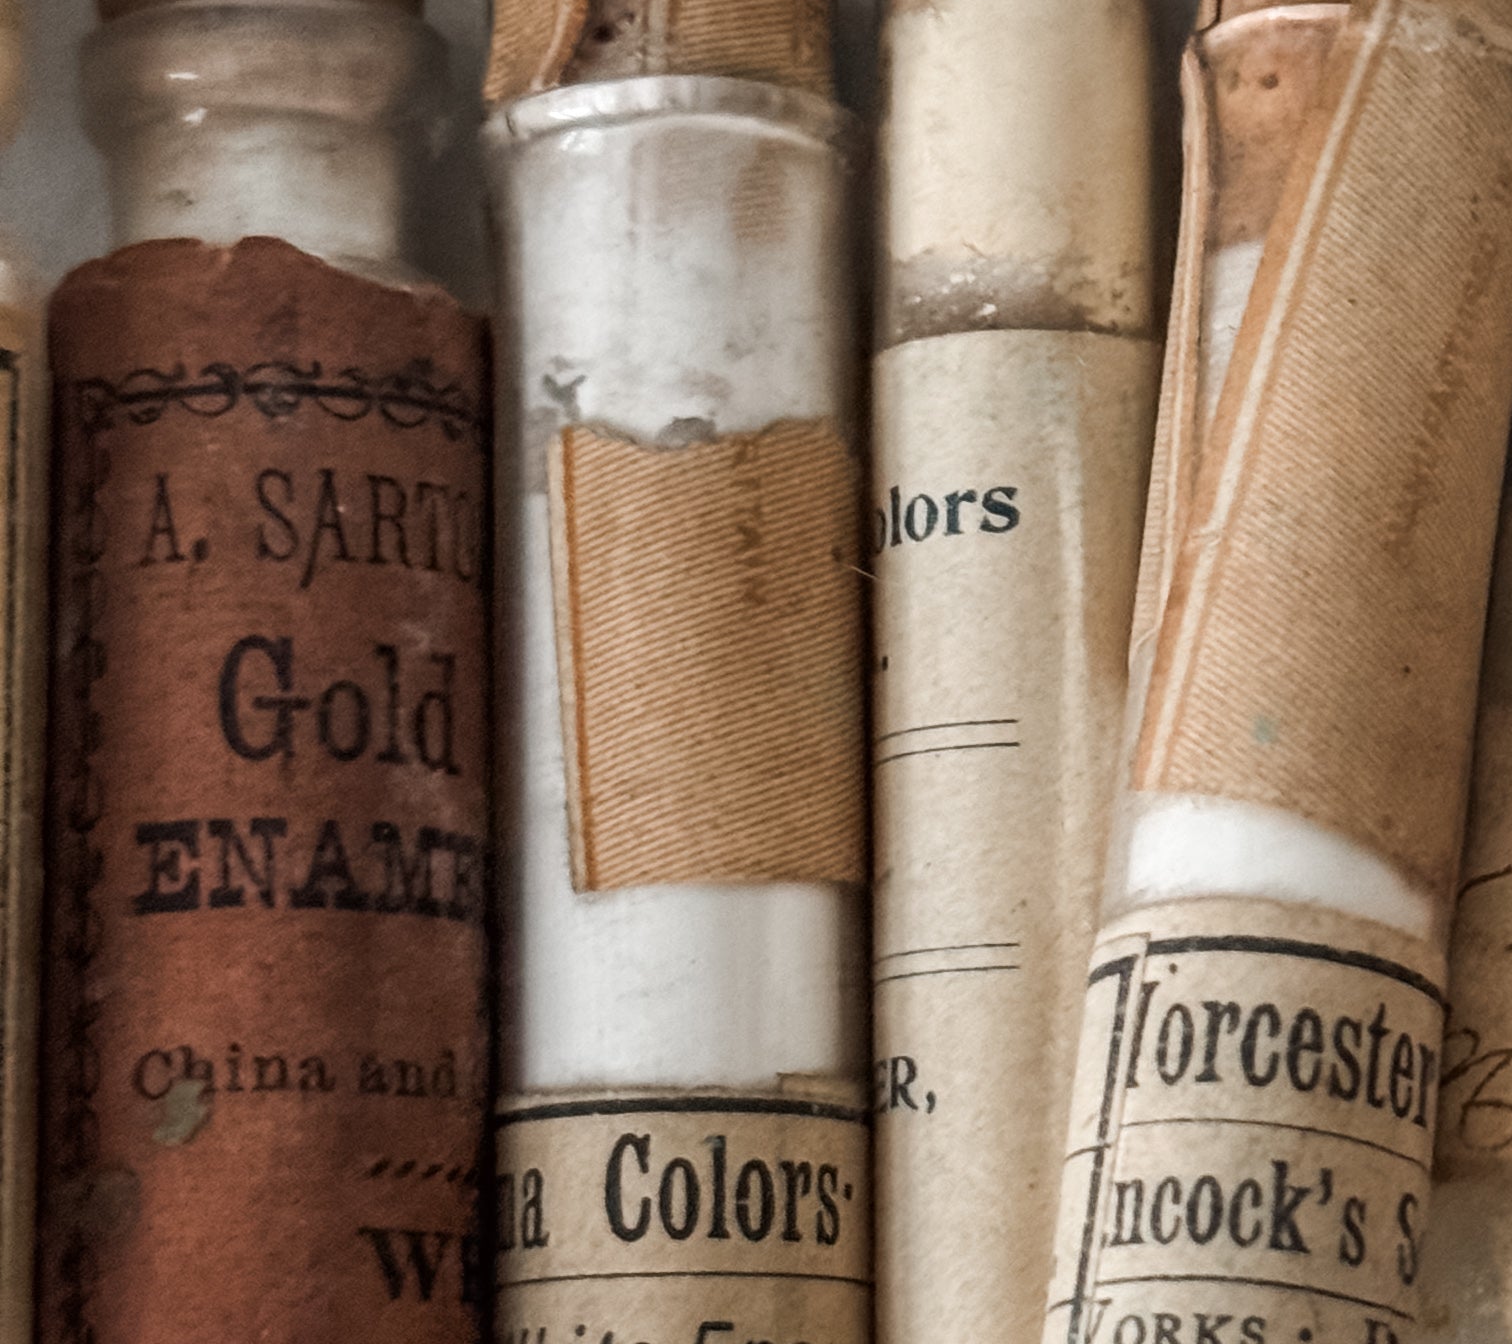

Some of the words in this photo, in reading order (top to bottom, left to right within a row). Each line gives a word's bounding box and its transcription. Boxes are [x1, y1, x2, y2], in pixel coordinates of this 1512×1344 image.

[217, 634, 462, 778] Gold
[132, 1042, 336, 1100] China
[357, 1050, 457, 1099] and
[1104, 1159, 1367, 1267] ncock's
